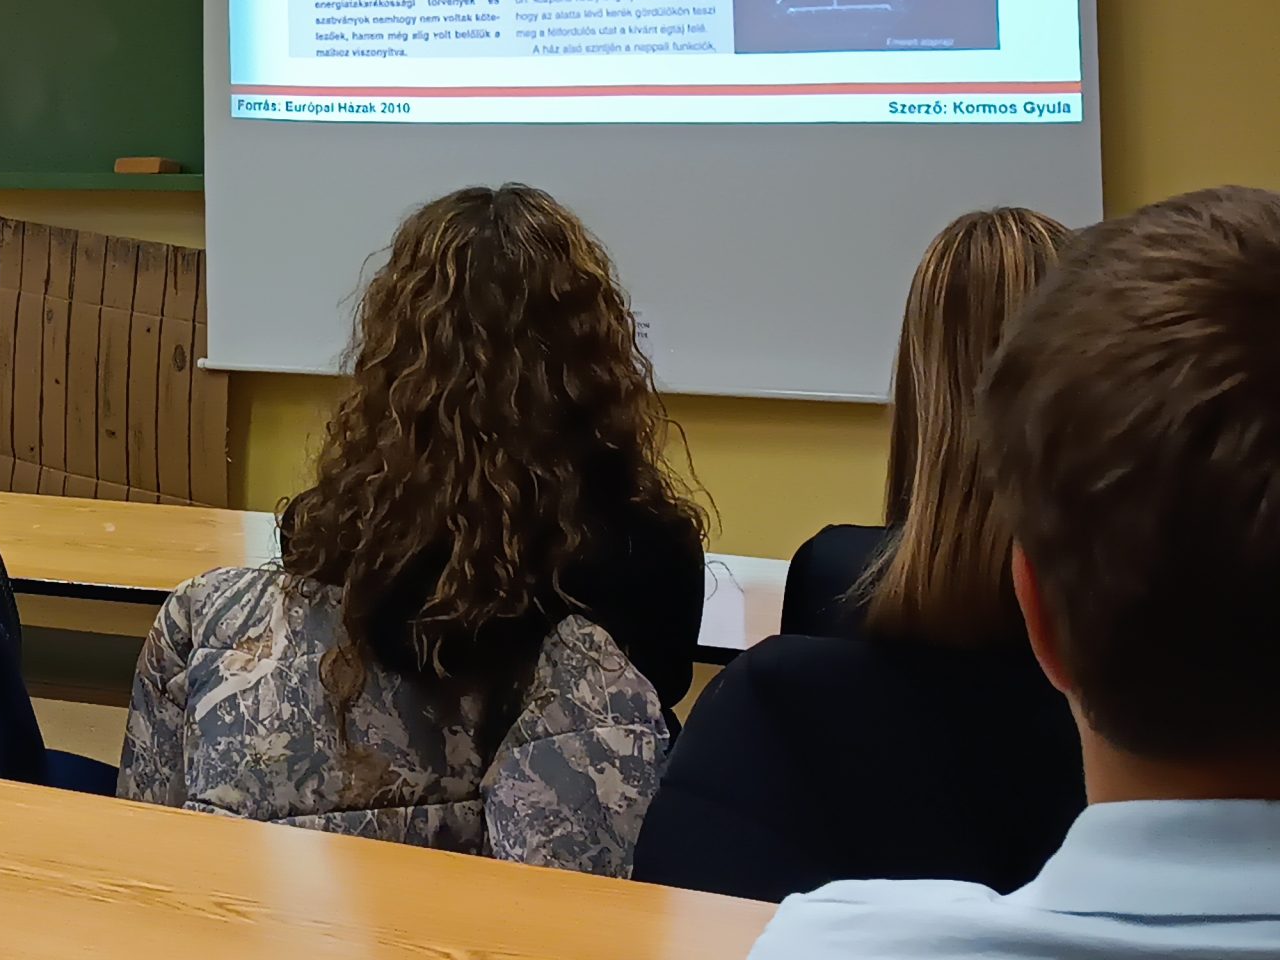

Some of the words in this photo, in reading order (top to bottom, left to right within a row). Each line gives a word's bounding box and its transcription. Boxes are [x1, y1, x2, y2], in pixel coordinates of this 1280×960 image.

[373, 15, 416, 25] nemhogy
[444, 14, 472, 22] voltak
[516, 12, 538, 22] hogy
[693, 6, 715, 15] teszi
[388, 31, 408, 41] még
[433, 30, 451, 39] volt
[517, 29, 536, 38] meg
[533, 45, 540, 53] A
[238, 99, 281, 112] Forrás:
[286, 101, 334, 115] Európai
[338, 101, 376, 113] Házak
[381, 102, 410, 113] 2010
[889, 100, 947, 115] Szerző:
[954, 101, 1017, 114] Kormos
[1023, 101, 1071, 117] Gyula
